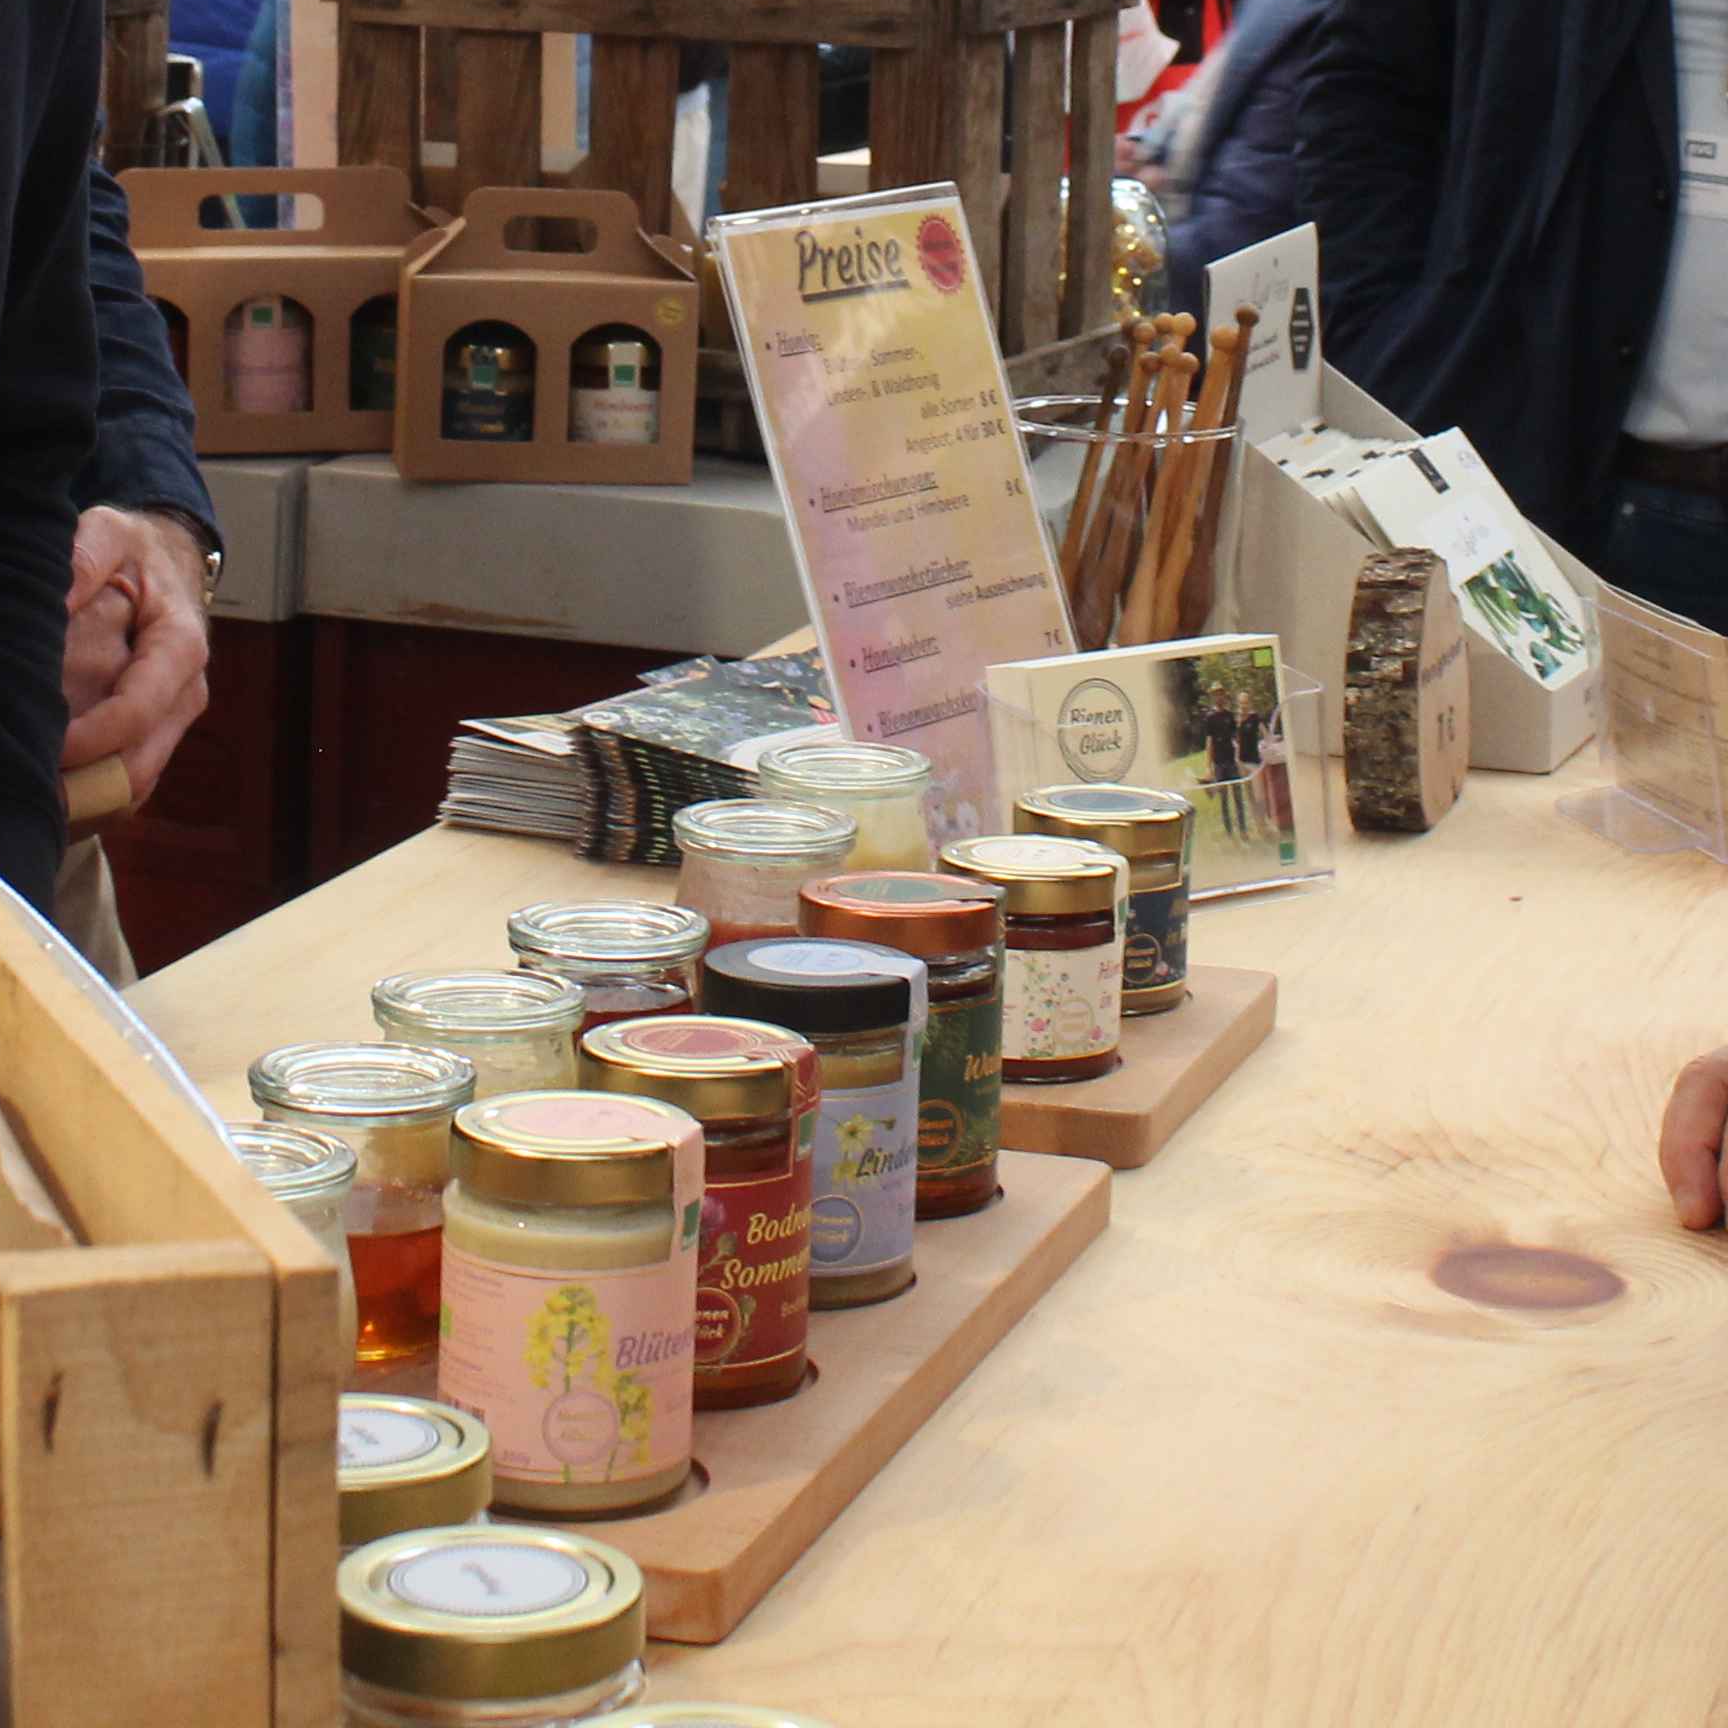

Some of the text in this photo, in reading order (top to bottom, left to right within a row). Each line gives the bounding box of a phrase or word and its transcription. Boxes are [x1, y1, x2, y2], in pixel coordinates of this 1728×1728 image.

[794, 225, 906, 293] Preise
[890, 506, 915, 525] und
[1070, 708, 1124, 725] Bienen
[1080, 728, 1123, 755] Glück
